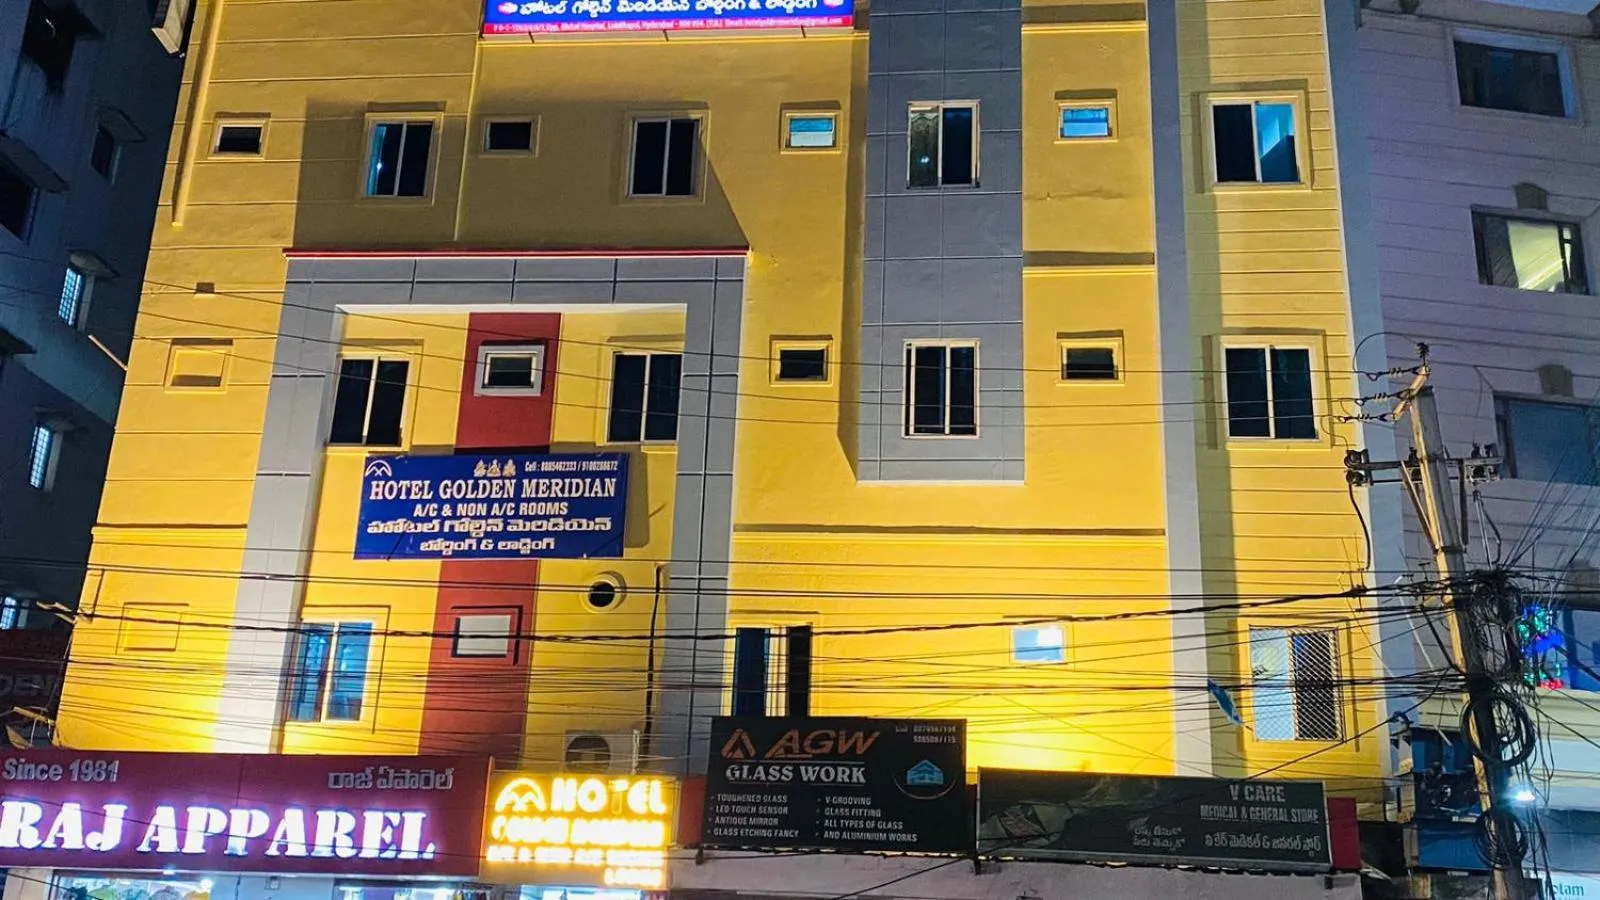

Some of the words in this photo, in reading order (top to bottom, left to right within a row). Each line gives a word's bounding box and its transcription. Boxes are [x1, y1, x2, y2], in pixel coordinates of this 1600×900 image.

[369, 480, 433, 500] HOTEL
[439, 479, 516, 500] GOLDEN
[521, 478, 616, 499] MERIDIAN
[413, 504, 438, 517] A/C
[441, 504, 451, 517] &
[456, 503, 488, 516] NON
[491, 502, 515, 516] A/C
[519, 502, 568, 516] ROOMS
[480, 539, 495, 551] &
[765, 728, 881, 758] AGW
[2, 759, 62, 781] Since
[69, 760, 119, 782] 1981
[328, 766, 374, 789] రాజ్
[725, 764, 794, 782] GLASS
[800, 766, 866, 784] WORK
[551, 777, 667, 815] HOTEL
[717, 793, 761, 803] TOUGHENED
[763, 794, 788, 803] GLASS
[1229, 784, 1239, 801] V
[1244, 784, 1286, 802] CARE
[715, 804, 730, 814] LED
[732, 805, 756, 814] TOUCH
[758, 806, 788, 815] SENSOR
[824, 807, 849, 817] GLASS
[851, 808, 882, 818] FITTING
[1200, 804, 1239, 820] MEDICAL
[1249, 806, 1289, 822] GENERAL
[1291, 808, 1320, 824] STORE
[714, 816, 747, 826] ANTIQUE
[749, 816, 779, 826] MIRROR
[824, 819, 838, 828] ALL
[840, 819, 864, 829] TYPES
[866, 820, 876, 829] OF
[877, 821, 904, 830] GLASS
[0, 800, 129, 853] RAJ
[137, 806, 437, 861] APPAREL
[713, 827, 739, 837] GLASS
[740, 828, 773, 838] ETCHING
[774, 829, 800, 838] FANCY
[824, 831, 840, 840] AND
[841, 831, 887, 842] ALUMINIUM
[888, 832, 918, 842] WORKS
